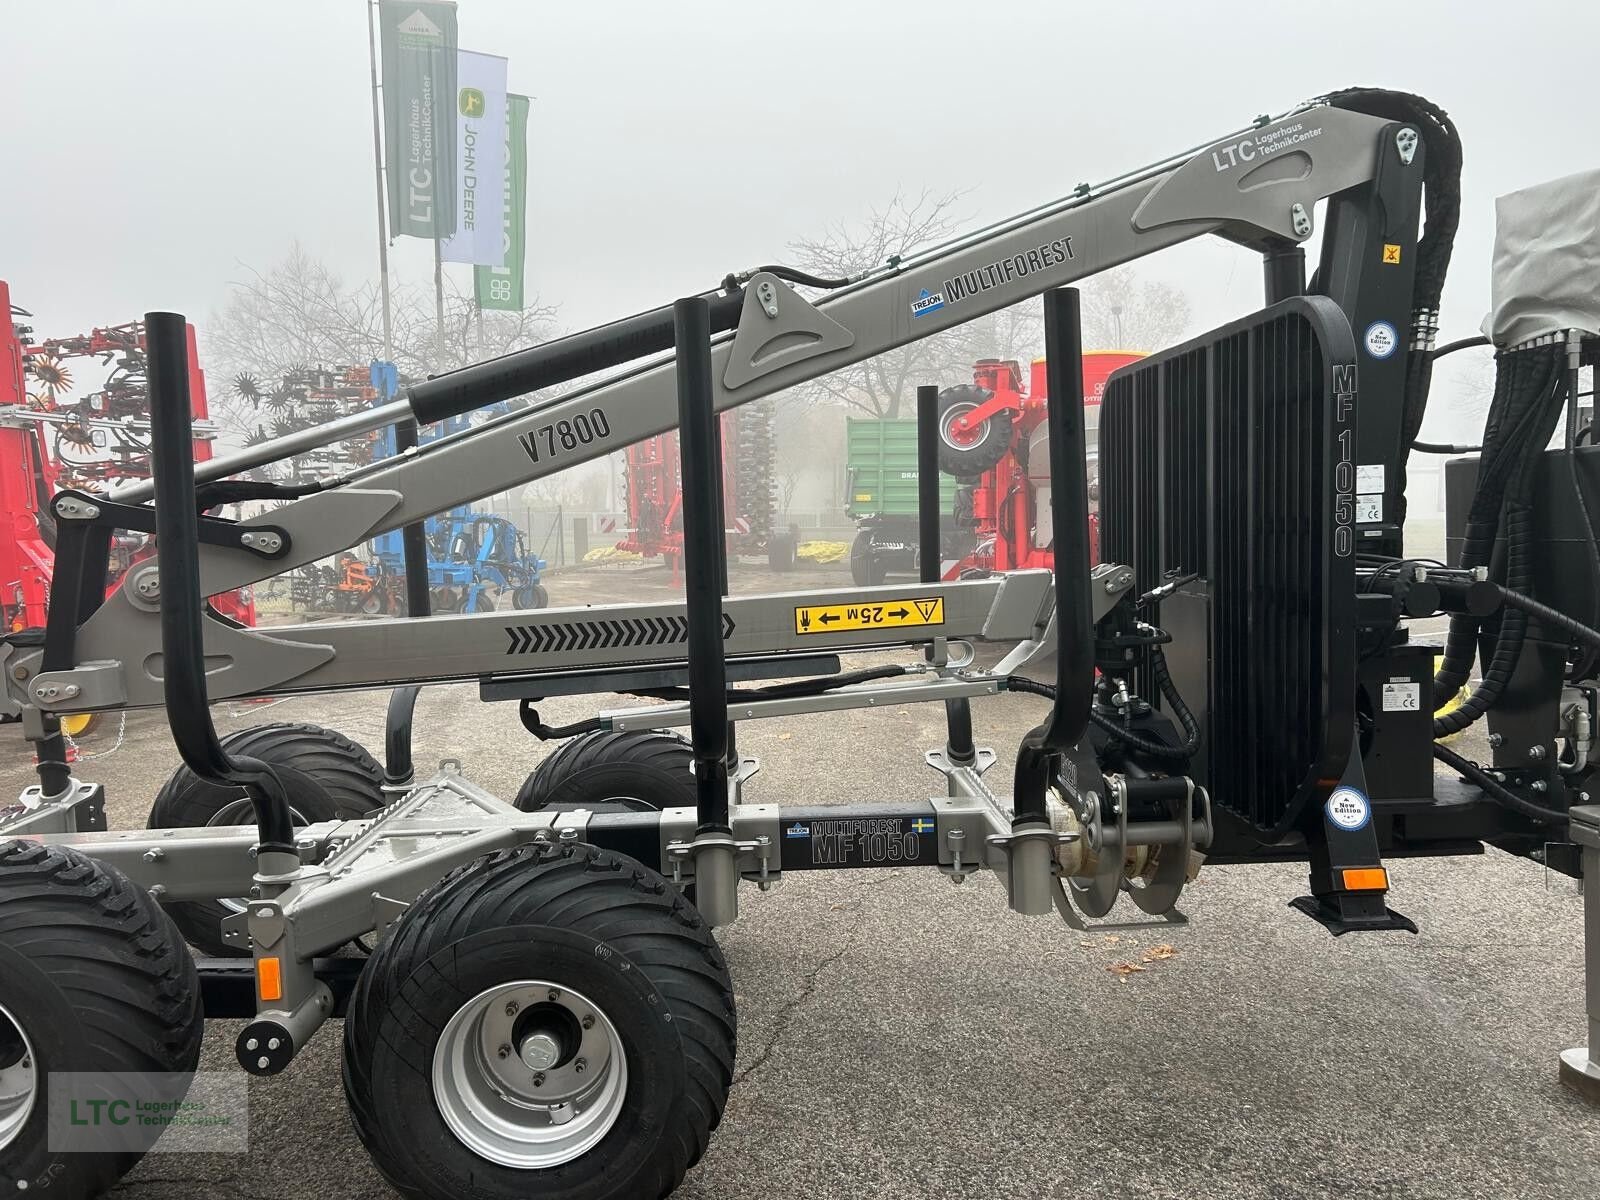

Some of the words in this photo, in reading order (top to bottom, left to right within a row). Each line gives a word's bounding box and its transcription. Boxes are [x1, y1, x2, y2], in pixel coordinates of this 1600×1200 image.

[409, 97, 421, 163] Lagerhaus
[463, 124, 478, 171] JOHN
[1255, 122, 1303, 146] Lagerhaus
[1257, 127, 1323, 156] TechnikCenter
[1212, 140, 1256, 172] LTC
[409, 167, 432, 222] LTC
[463, 176, 477, 231] DEERE
[911, 294, 942, 312] TREJON
[943, 235, 1075, 305] MULTIFOREST
[1333, 364, 1357, 422] MF
[1335, 429, 1353, 557] 1050
[811, 819, 902, 836] MULTIFOREST
[812, 834, 854, 864] MF
[858, 832, 920, 862] 1050
